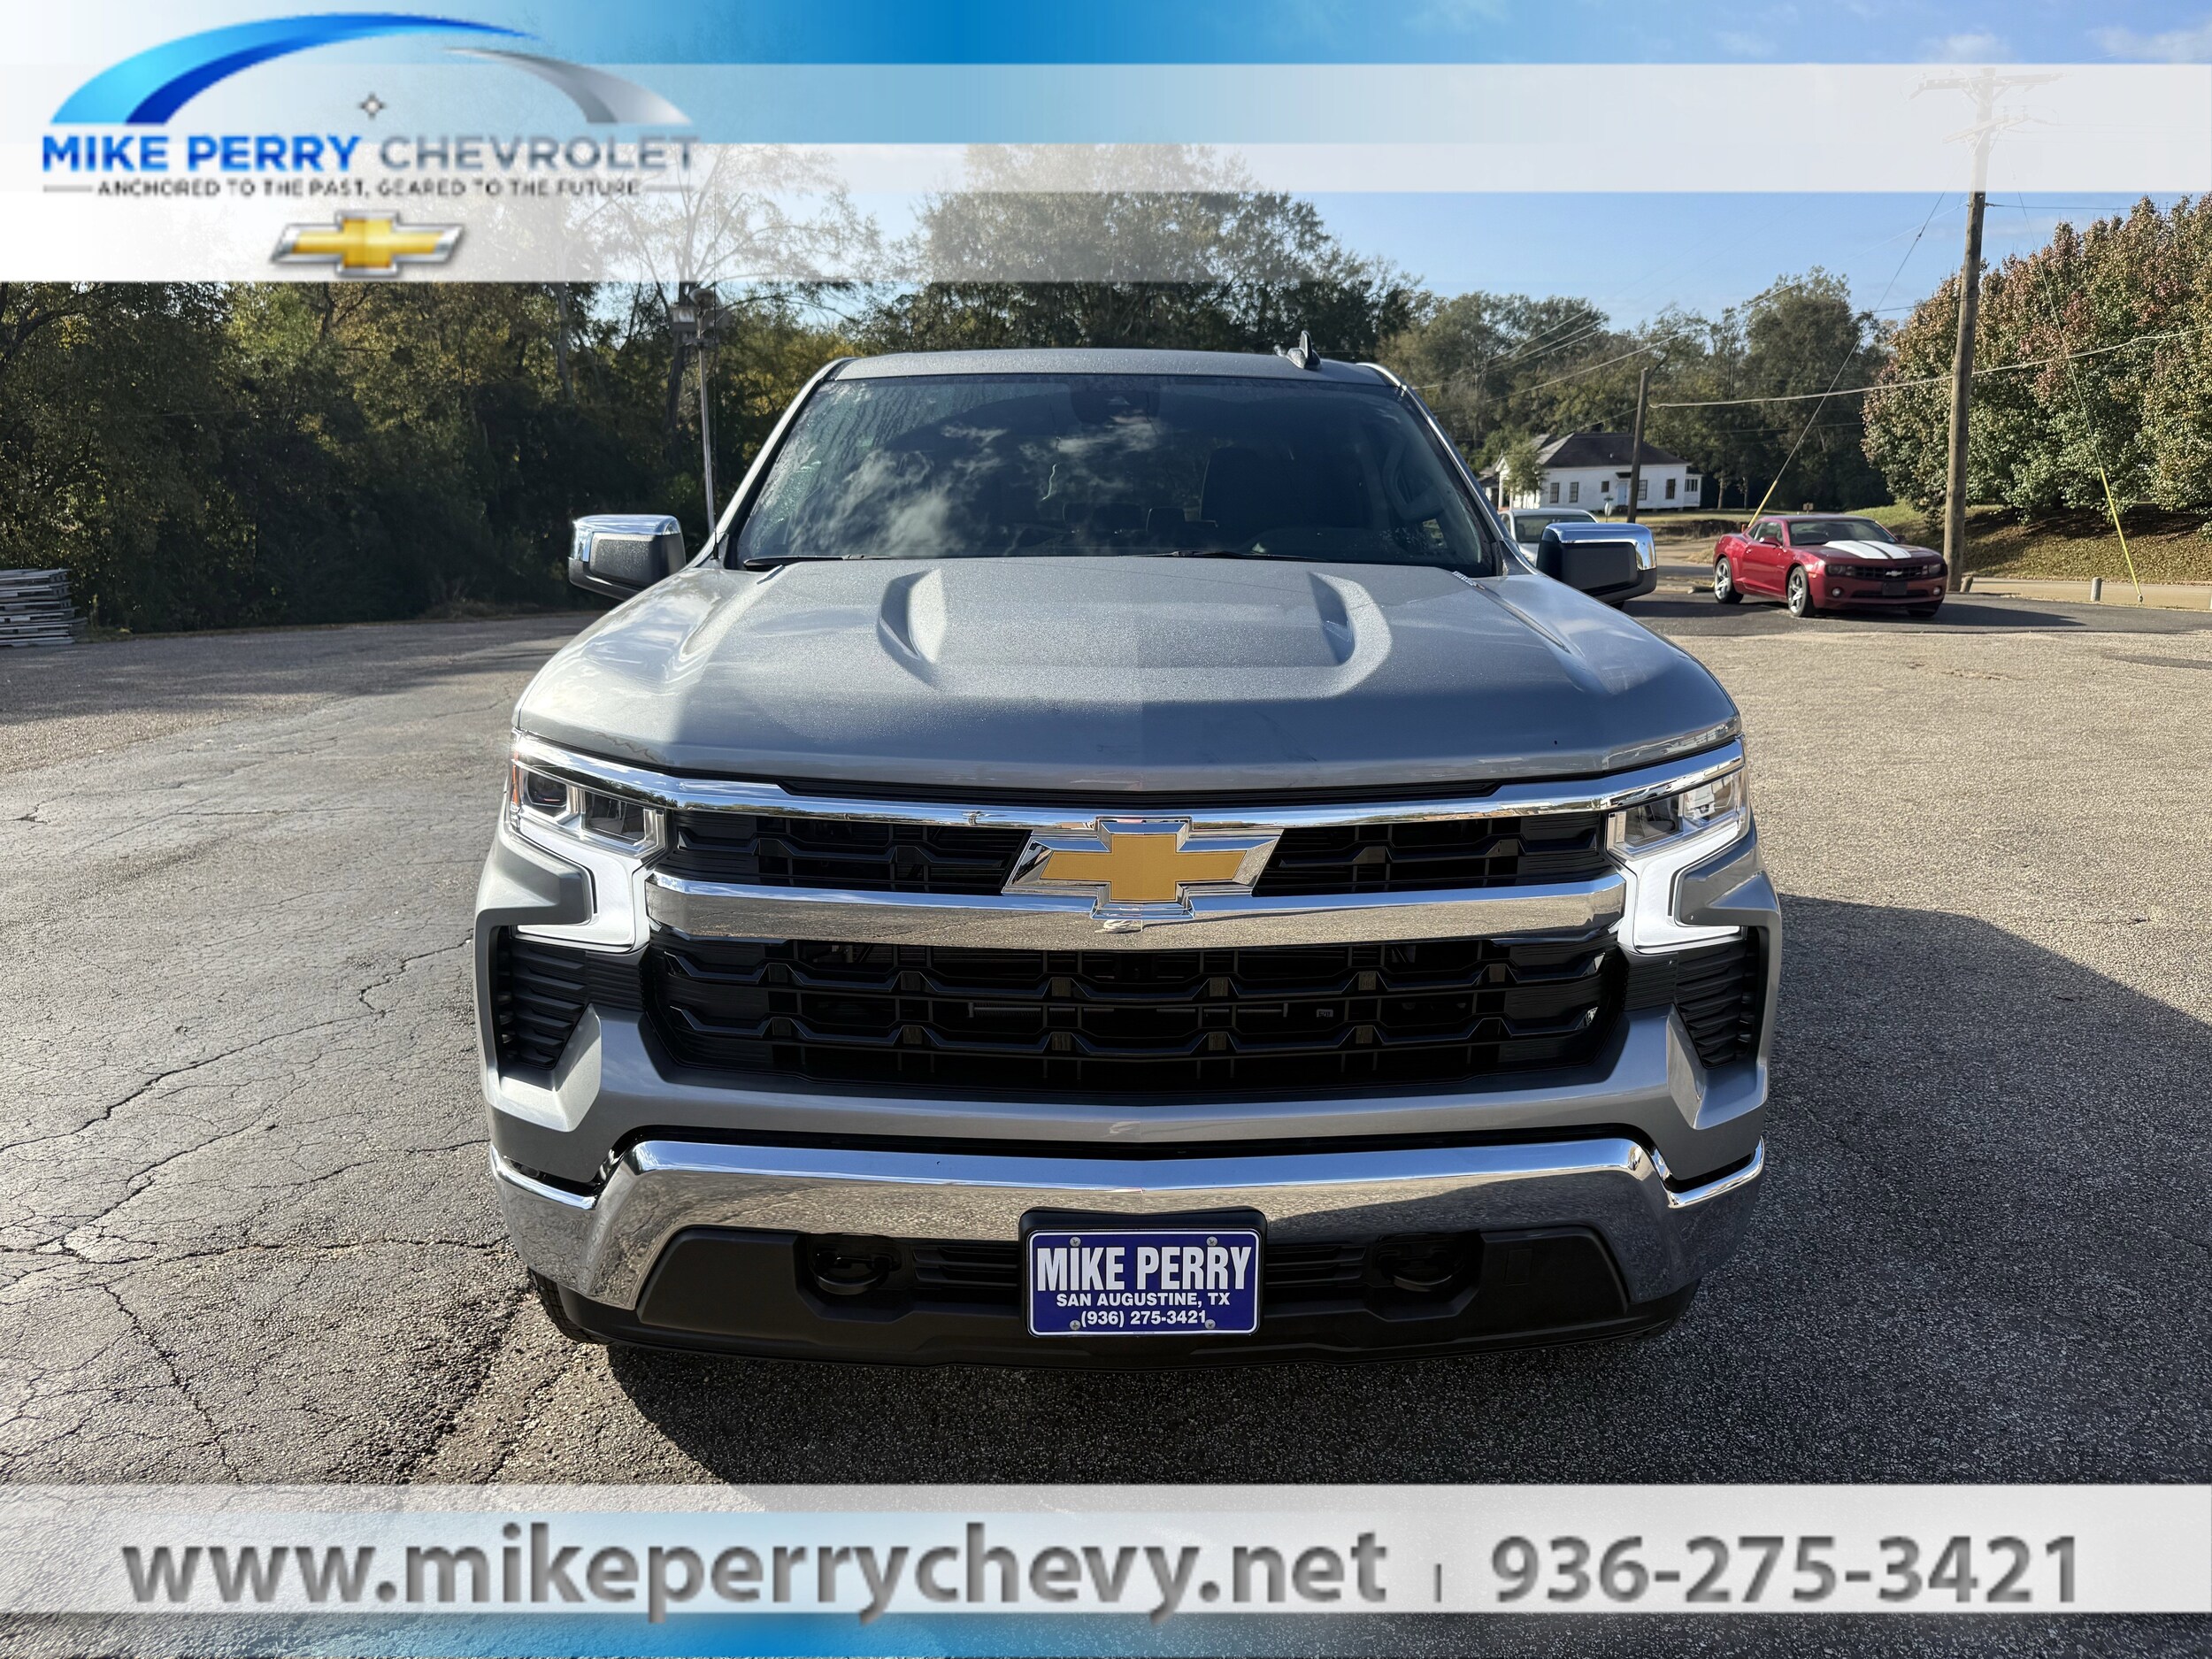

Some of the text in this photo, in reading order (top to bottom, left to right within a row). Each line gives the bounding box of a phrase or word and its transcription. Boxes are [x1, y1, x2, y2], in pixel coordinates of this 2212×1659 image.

[1037, 1246, 1252, 1292] MIKE PERRY
[1056, 1292, 1231, 1309] SAN AUGUSTINE, TX
[1080, 1310, 1207, 1328] (936) 275-3421
